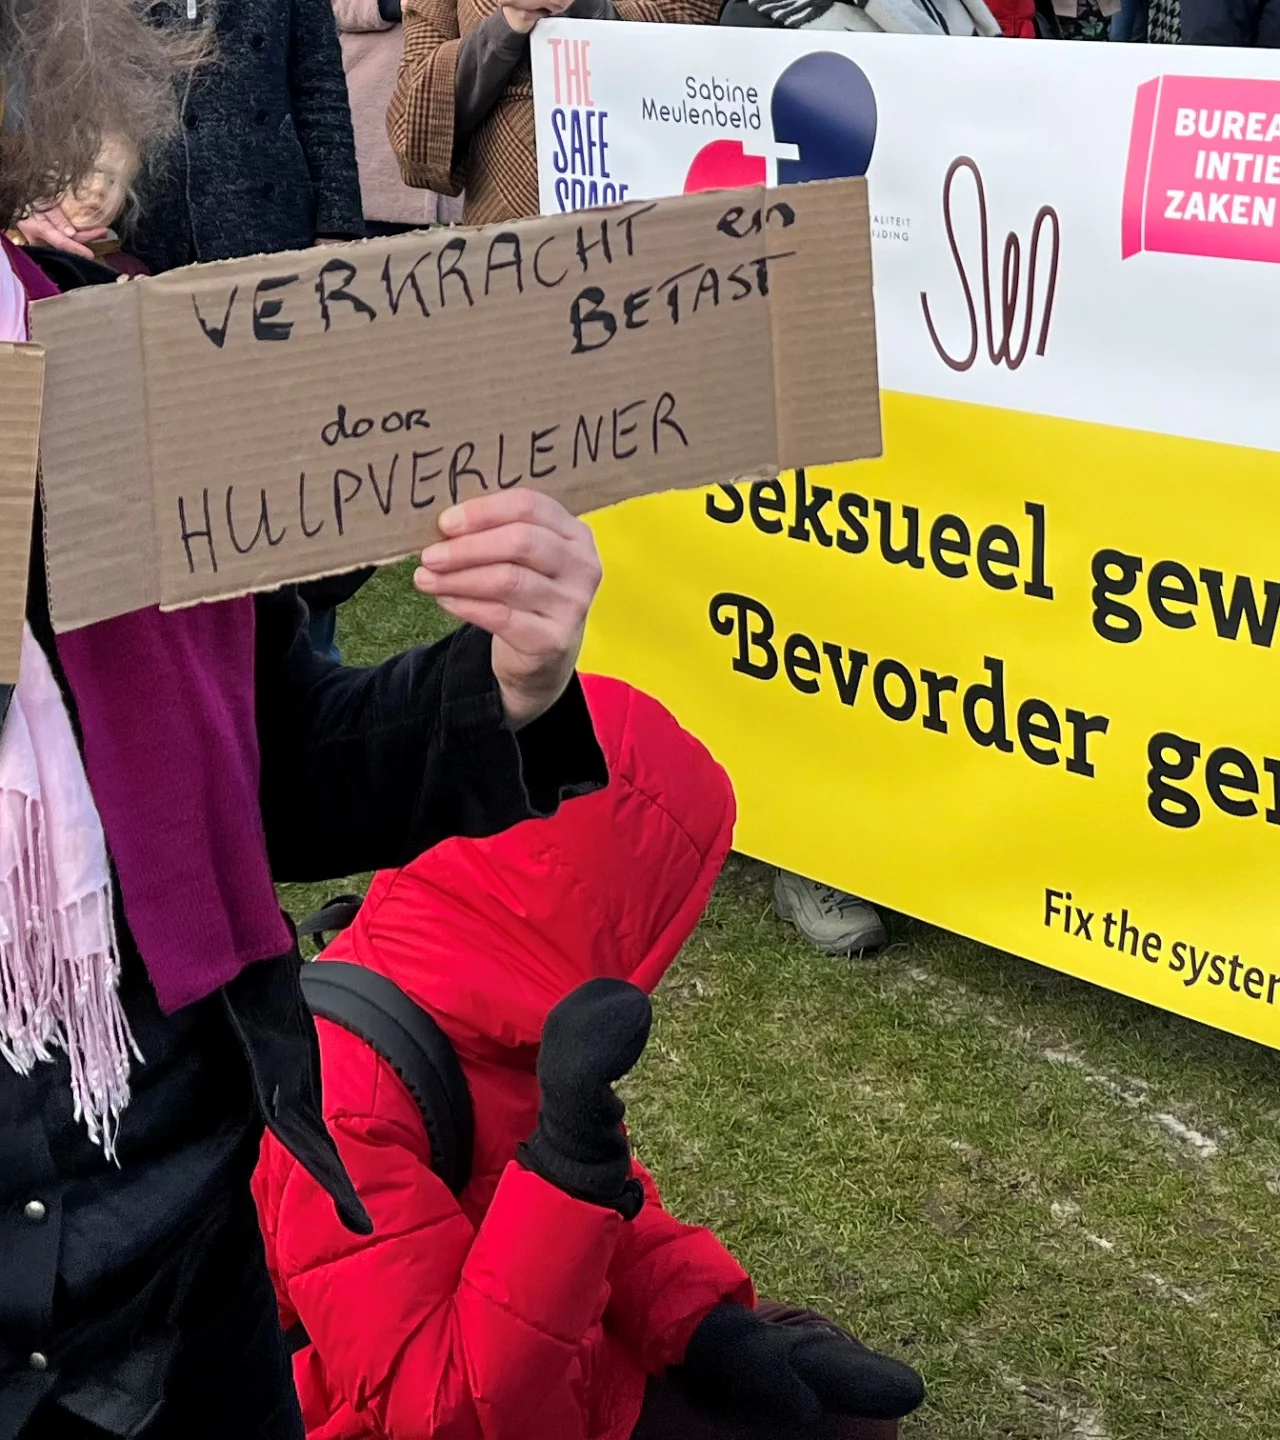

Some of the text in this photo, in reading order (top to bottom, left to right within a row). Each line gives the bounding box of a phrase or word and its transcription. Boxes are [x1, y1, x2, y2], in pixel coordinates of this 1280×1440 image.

[548, 38, 594, 106] THE
[685, 76, 758, 104] Sabine
[551, 108, 610, 178] SAFE
[642, 97, 761, 130] Meulenbeld
[1164, 189, 1276, 227] ZAKEN
[191, 204, 657, 348] VERKRACHT
[569, 251, 797, 354] BETAST
[177, 391, 688, 574] HULPVERLENER
[705, 467, 1054, 601] Seksueel
[708, 592, 1109, 778] Bevorder
[1044, 888, 1093, 942] Fix
[1103, 908, 1162, 963] the
